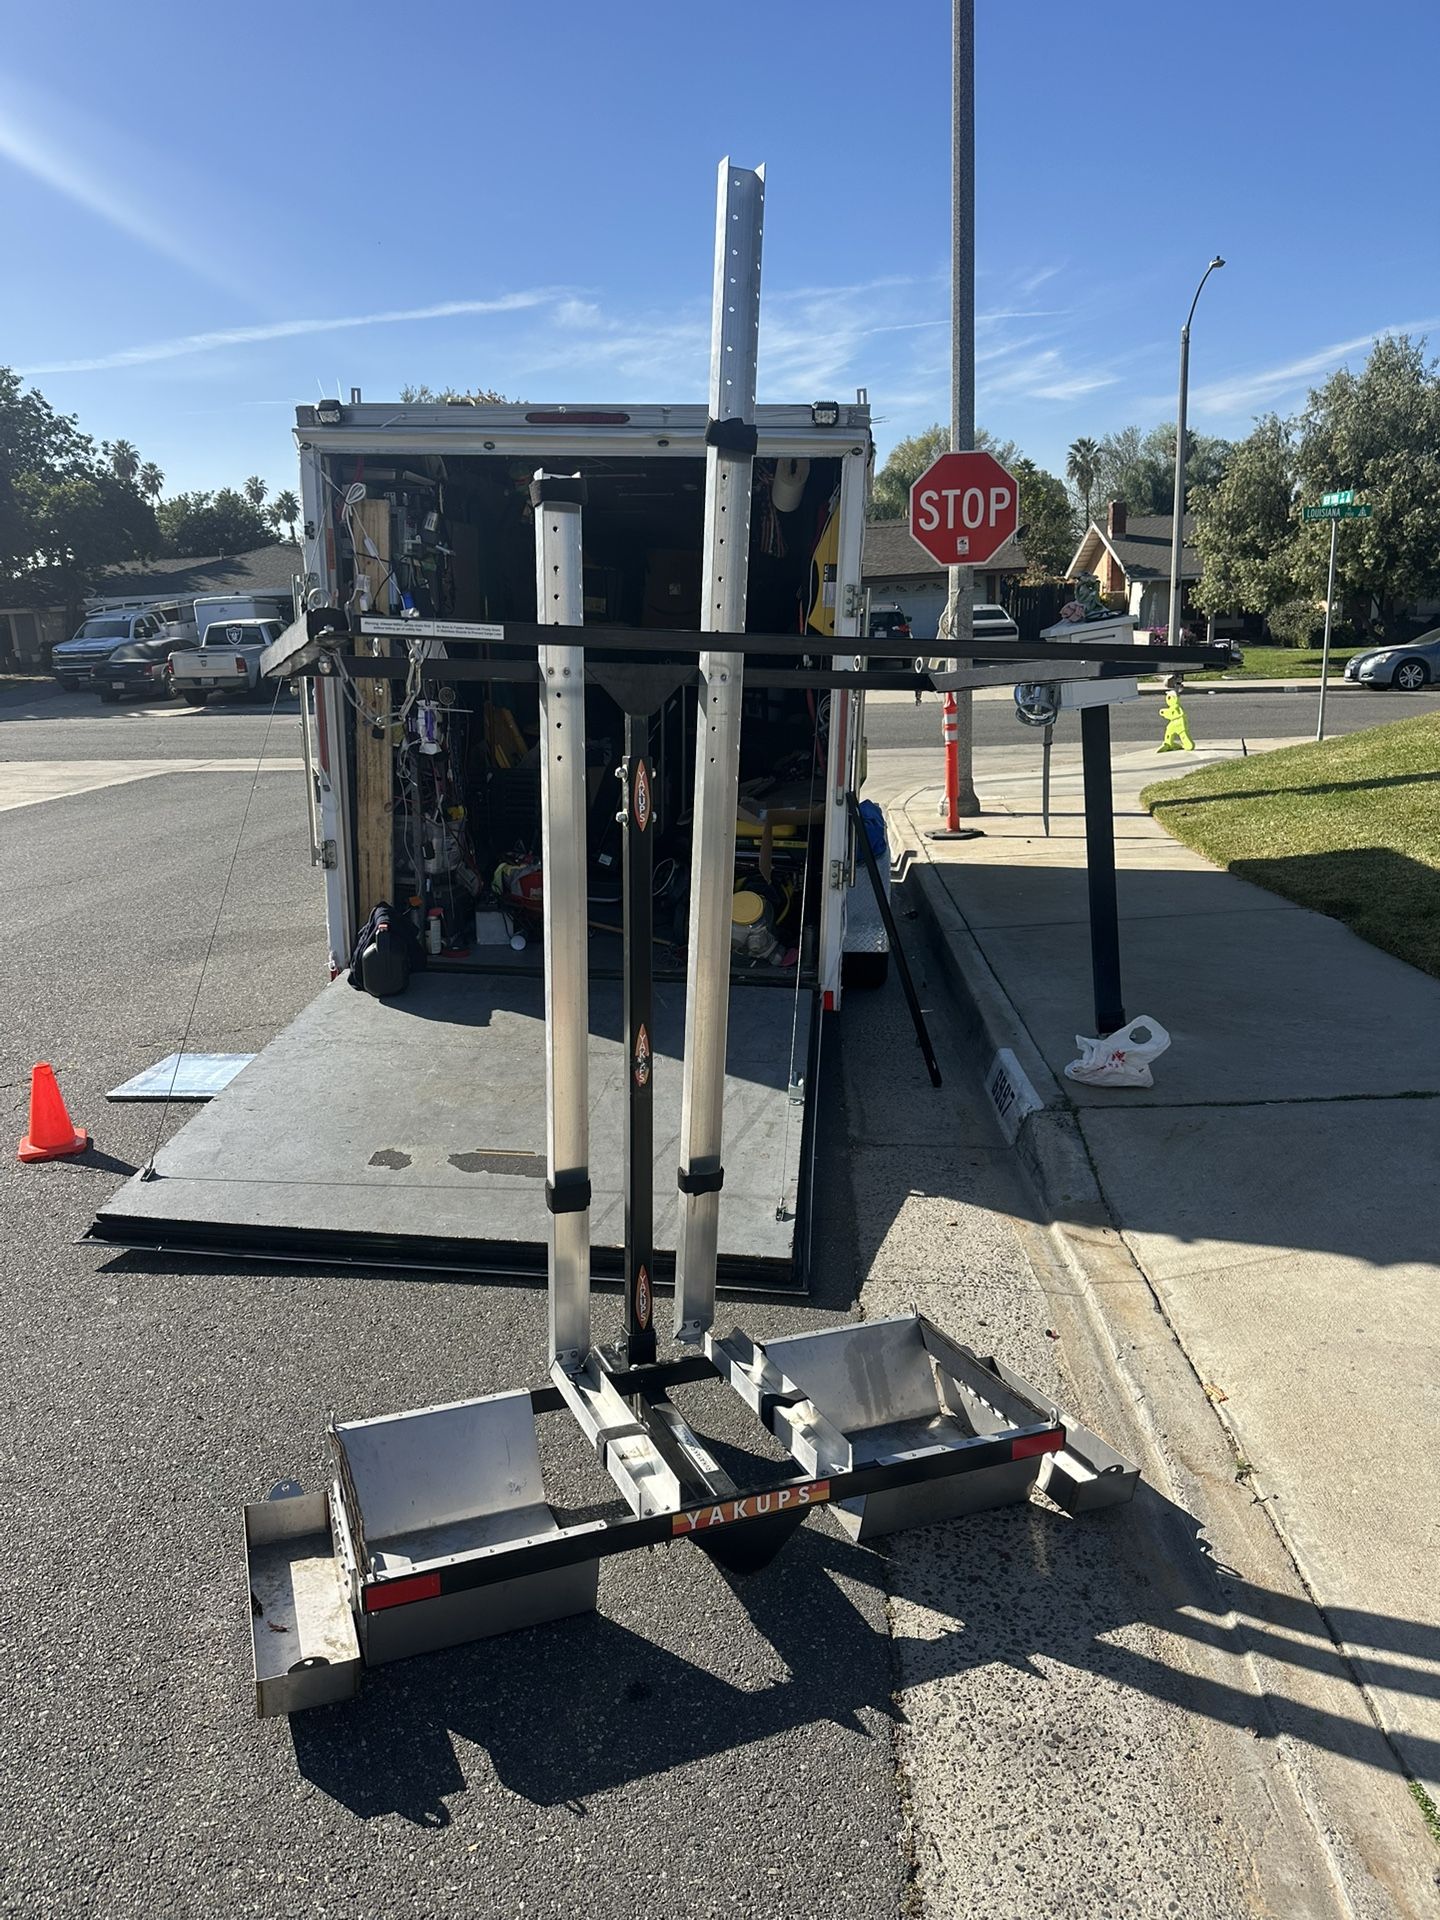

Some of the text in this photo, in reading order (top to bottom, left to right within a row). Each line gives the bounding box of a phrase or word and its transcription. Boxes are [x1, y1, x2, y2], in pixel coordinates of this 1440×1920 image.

[919, 487, 1011, 531] STOP
[1307, 508, 1341, 518] LOUISIANA
[638, 771, 646, 823] YAKUPS
[639, 1275, 647, 1322] YAKUPS
[686, 1485, 812, 1530] YAKUPS
